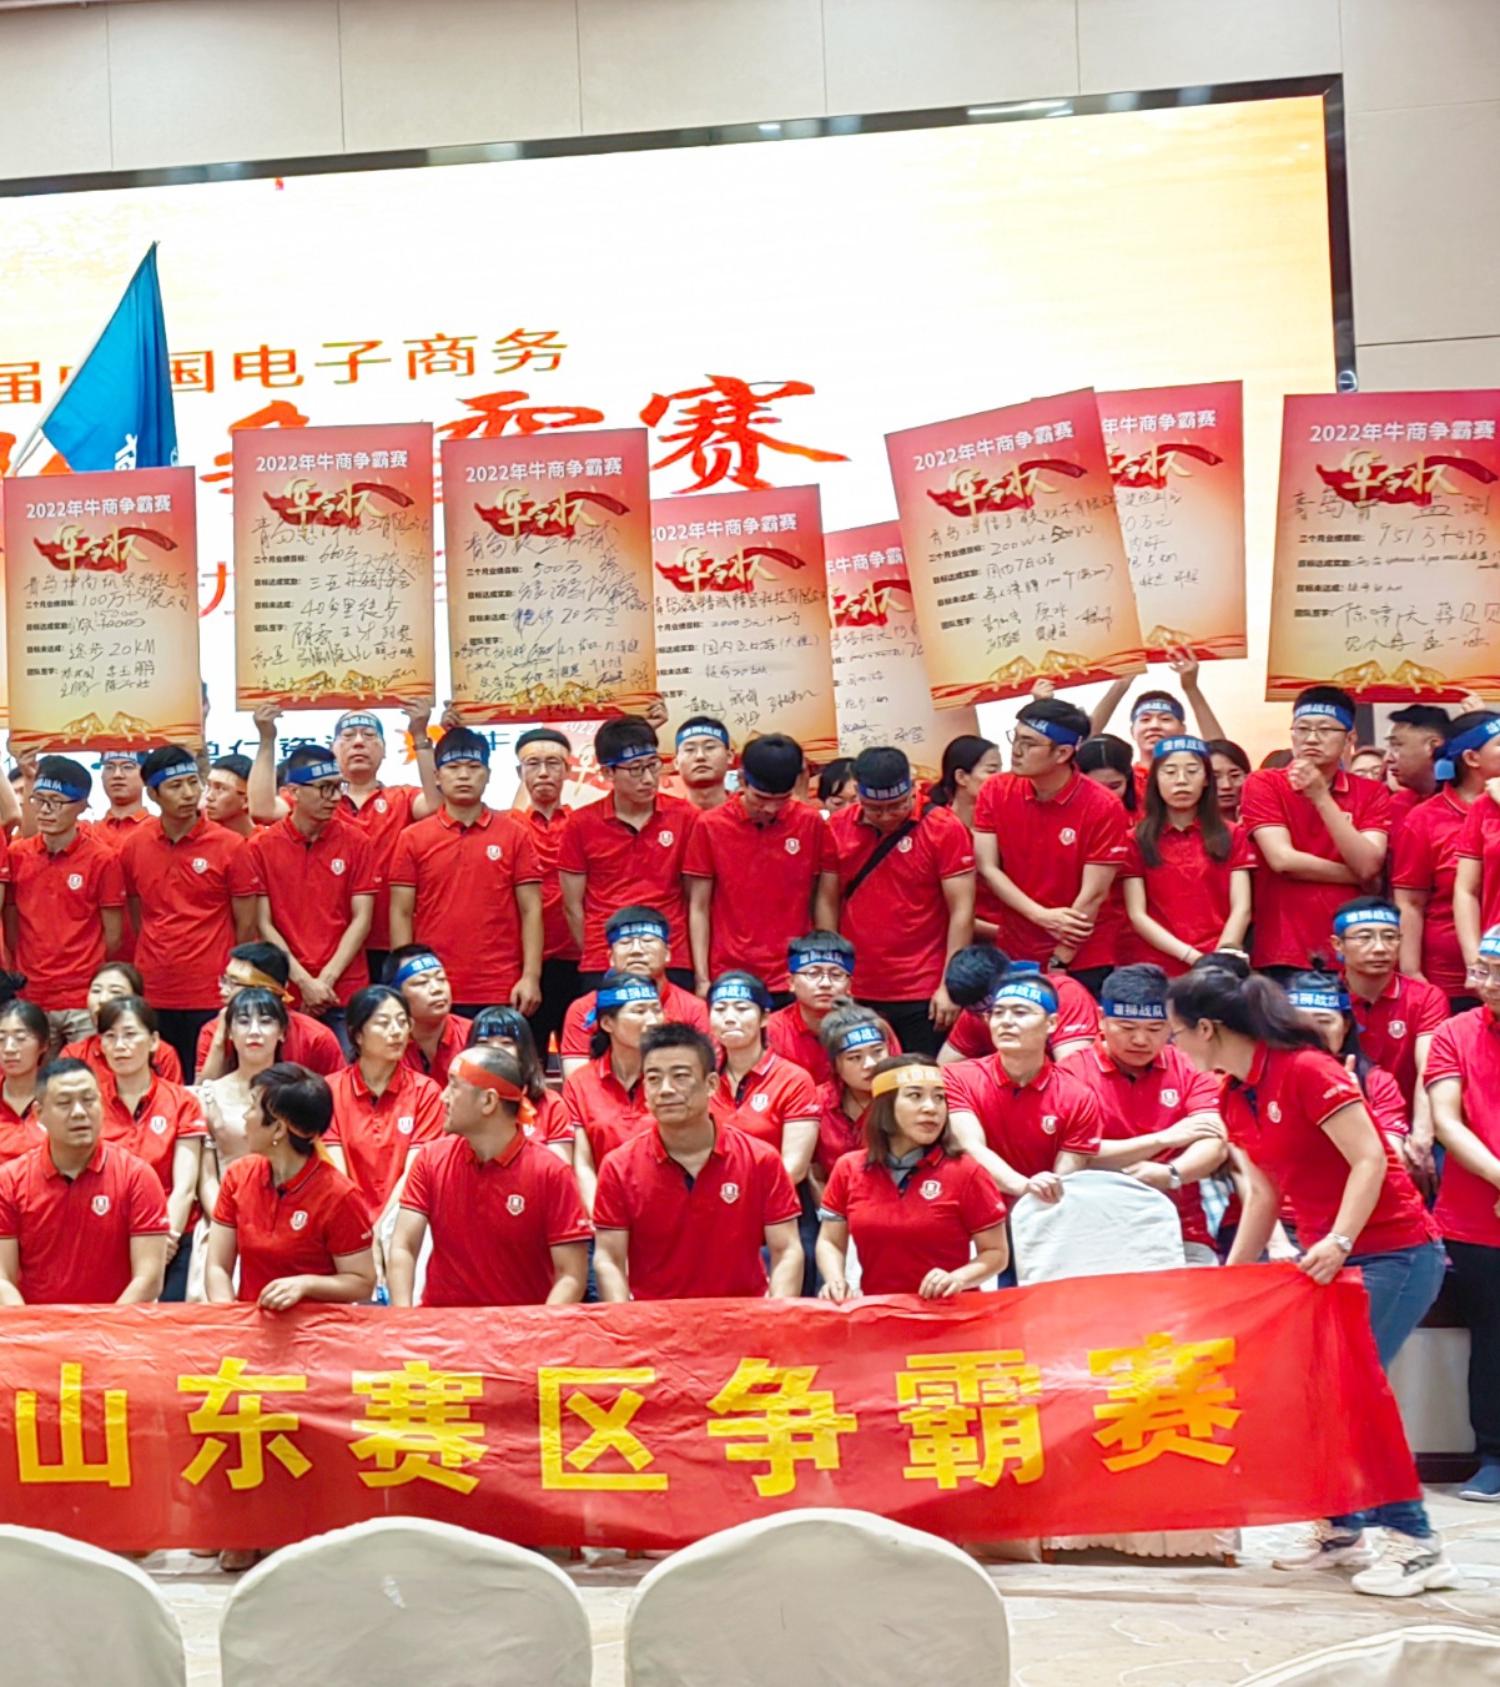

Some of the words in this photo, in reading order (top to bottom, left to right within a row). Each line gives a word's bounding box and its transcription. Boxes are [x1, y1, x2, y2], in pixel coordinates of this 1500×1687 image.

[1102, 410, 1216, 434] 年牛商争霸赛
[1309, 420, 1496, 442] 2022年牛商争霸赛
[913, 421, 1074, 471] 2022年牛商争霸赛
[256, 450, 408, 472] 2022年牛商争霸赛
[466, 457, 623, 483] 2022年牛商争霸赛
[26, 495, 171, 519] 2022年牛商争霸赛
